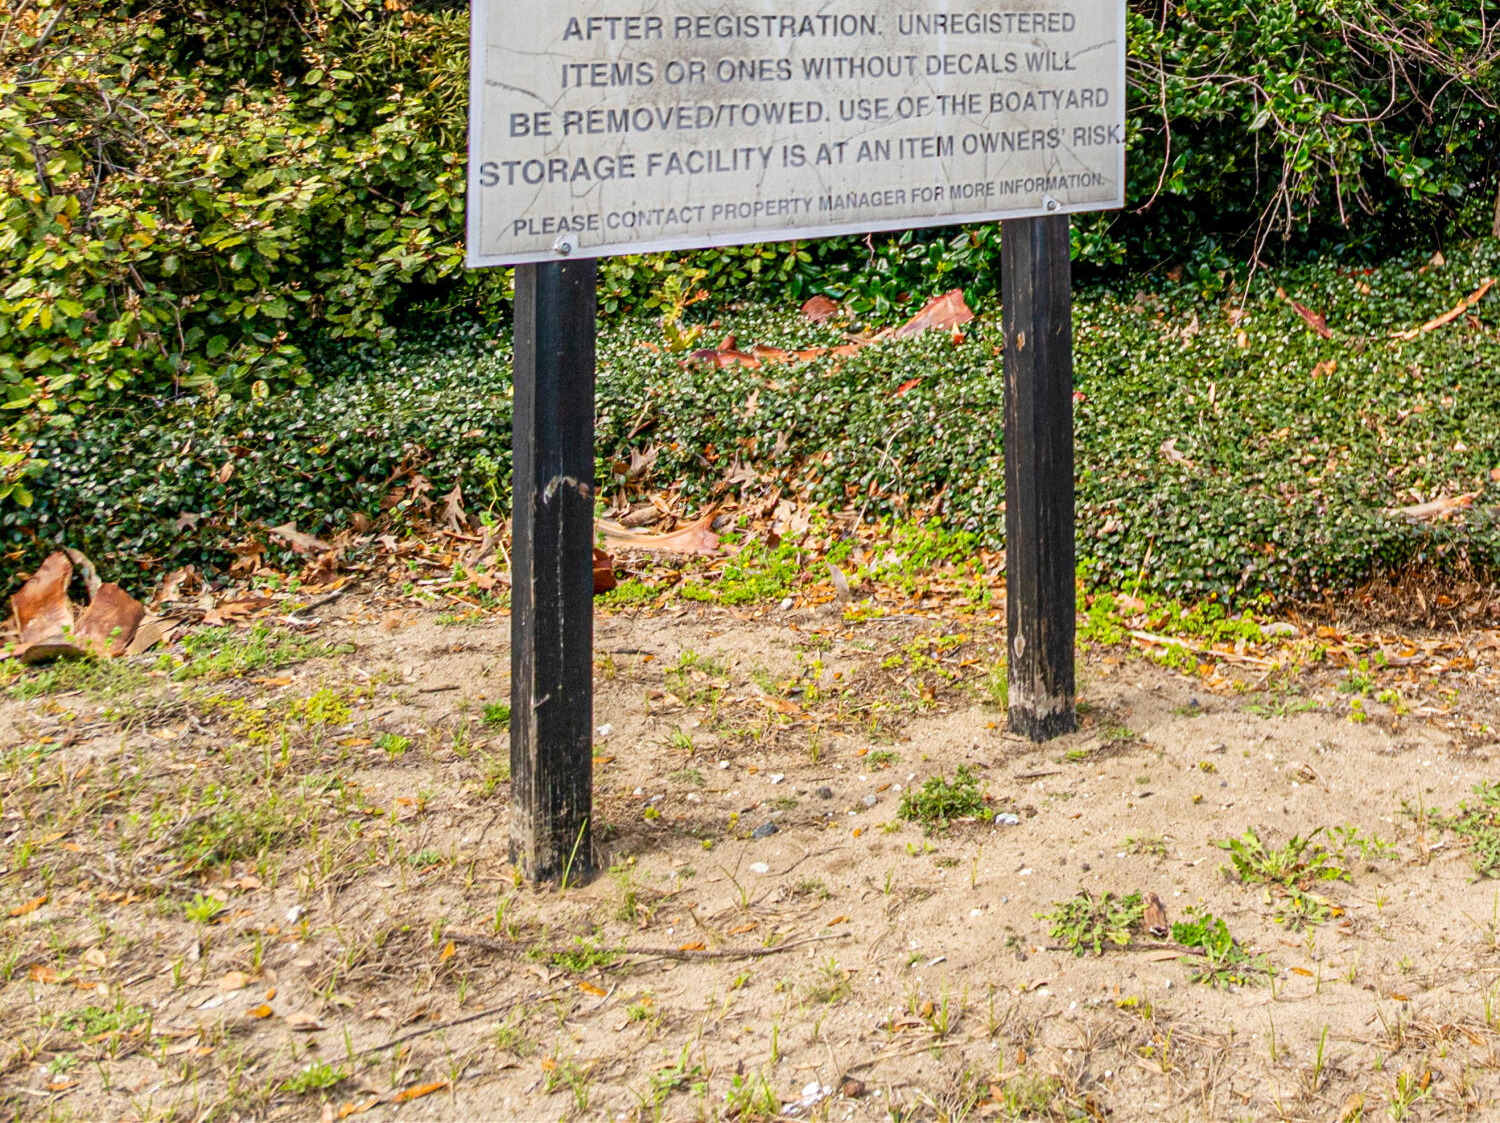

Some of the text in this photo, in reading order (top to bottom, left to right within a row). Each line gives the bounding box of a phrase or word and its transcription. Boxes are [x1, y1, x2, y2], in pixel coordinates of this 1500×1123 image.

[562, 12, 1076, 41] AFTER REGISTRATION. UNREGISTERED
[561, 50, 1077, 88] ITEMS OR ONES WITHOUT DECALS WILL
[510, 87, 1109, 138] BE REMOVED/TOWED. USE OF THE BOATYARD
[480, 154, 636, 188] STORAGE
[647, 146, 773, 177] FACILITY
[783, 144, 806, 168] IS
[816, 141, 849, 165] AT
[857, 139, 891, 163] AN
[899, 135, 954, 160] ITEM
[513, 173, 1105, 236] PLEASE CONTACT PROPERTY MANAGER FOR MORE INFORMATION.
